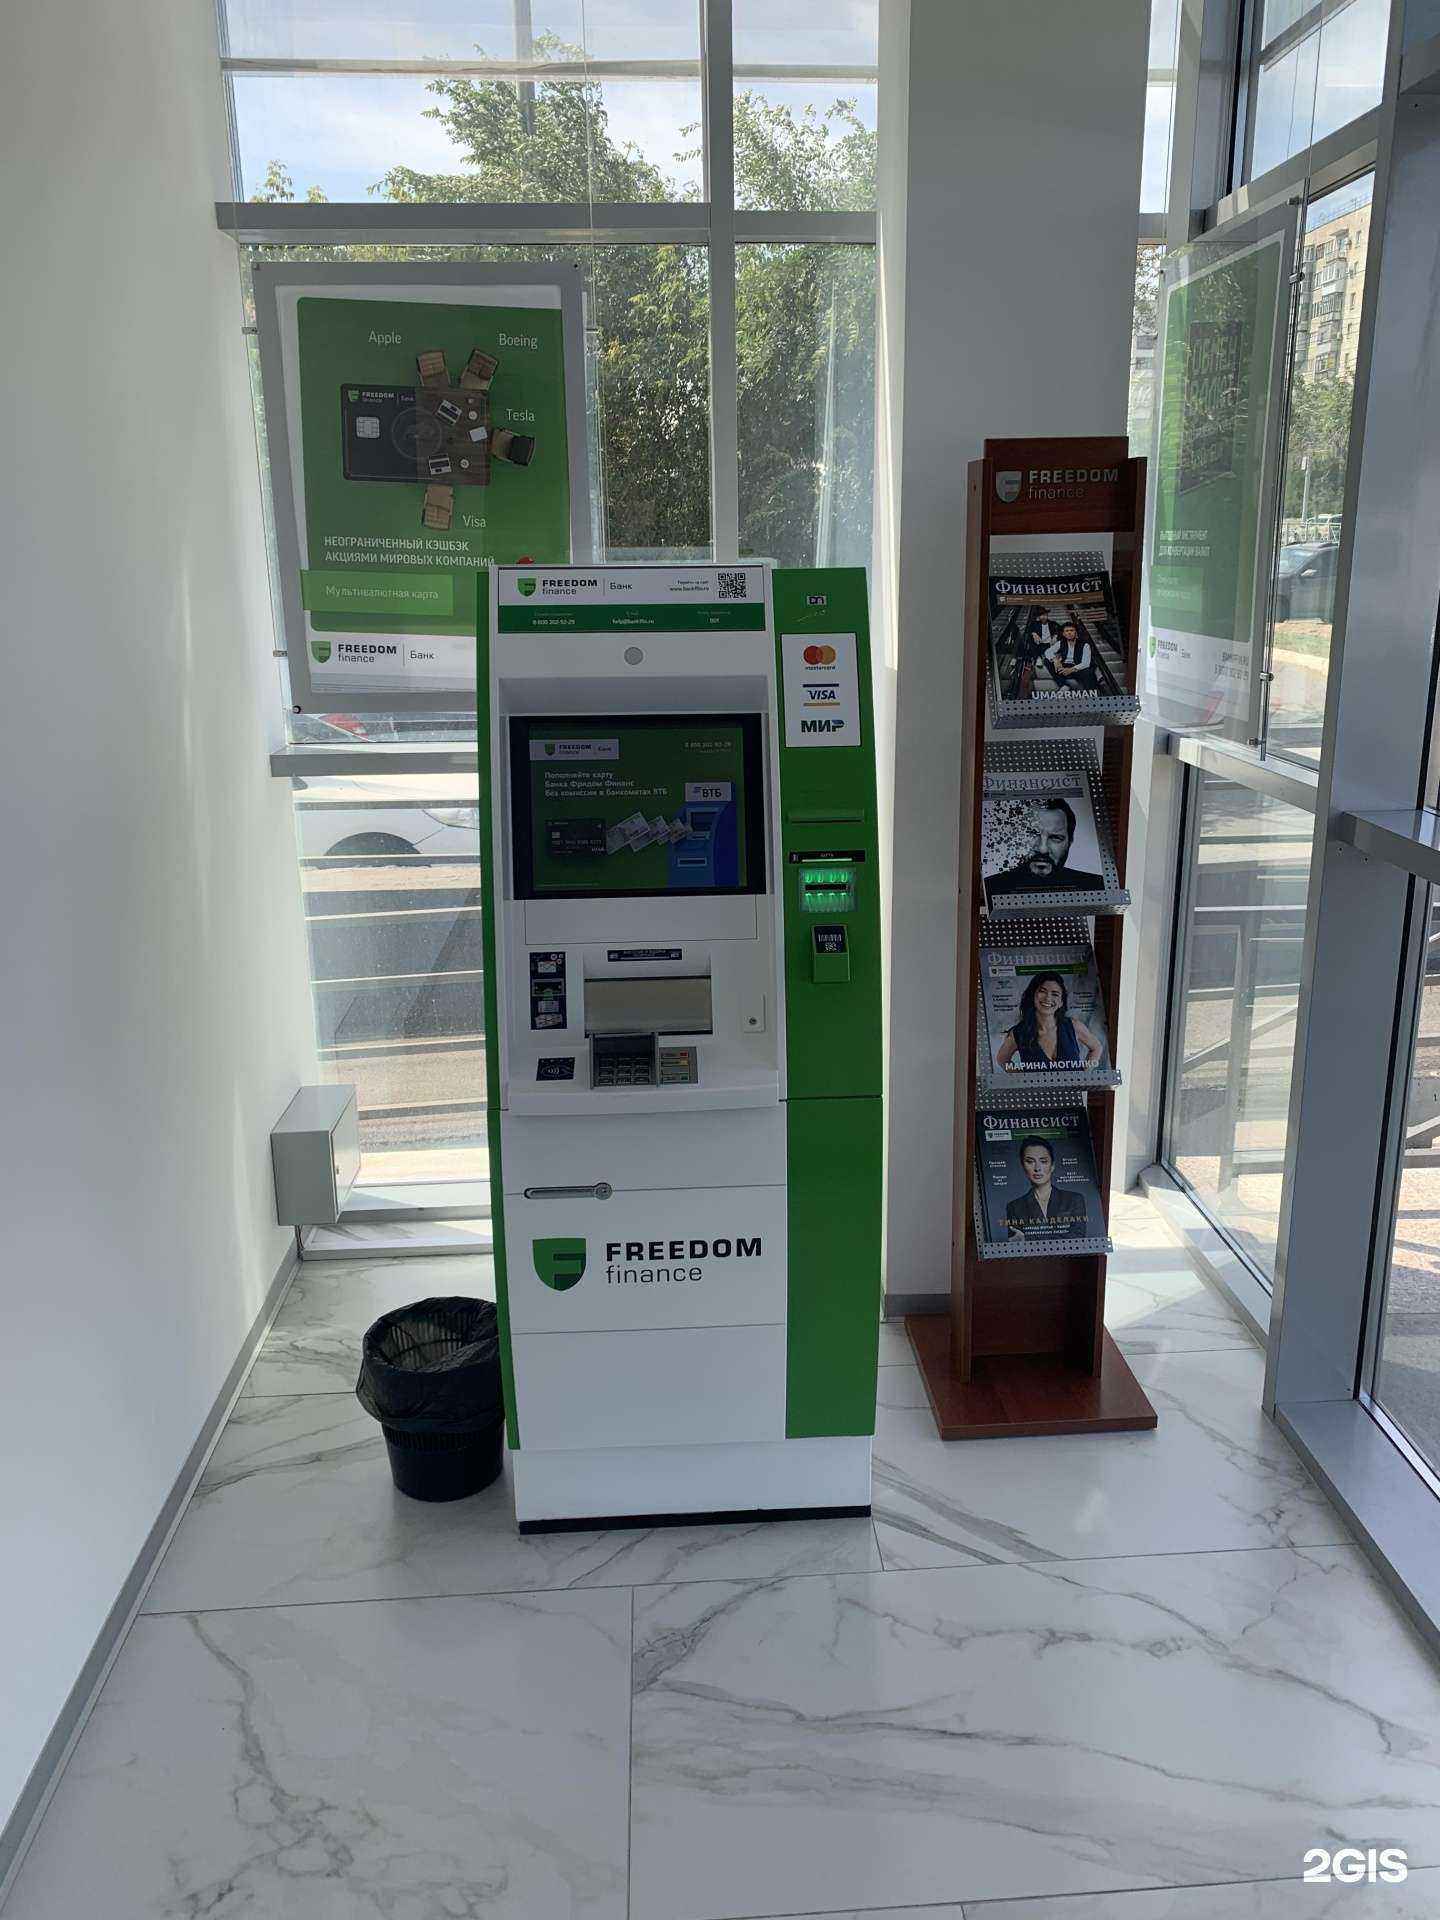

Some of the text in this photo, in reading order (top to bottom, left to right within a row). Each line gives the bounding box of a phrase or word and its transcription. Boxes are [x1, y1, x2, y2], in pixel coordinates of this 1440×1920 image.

[369, 330, 402, 345] Apple
[498, 333, 538, 350] Boeing
[506, 408, 536, 422] Tesla
[1029, 469, 1119, 483] FREEDOM
[1029, 486, 1085, 499] finance
[463, 515, 487, 528] Visa
[324, 536, 469, 551] НЕОГРАНИЧЕННЫЙ КЭШБЭК
[325, 551, 496, 567] АКЦИЯМИ МИРОВЫХ КОМПАНИЙ
[542, 579, 597, 587] FREEDOM
[610, 582, 632, 590] Банк
[995, 579, 1102, 593] Финансист
[326, 585, 439, 601] Мультивалютная карта
[542, 587, 577, 595] finance
[338, 644, 397, 654] FREEDOM
[410, 650, 434, 660] Банк
[338, 654, 375, 663] finance
[808, 690, 836, 700] VISA
[1031, 689, 1098, 700] UMA2RMAN
[801, 720, 844, 732] МИР
[702, 788, 721, 798] ВТБ
[1004, 1060, 1099, 1071] МАРИНА МОГИЛКО
[983, 1115, 1079, 1129] Финансист
[1029, 1216, 1088, 1225] КАНДЕЛАКИ
[606, 1237, 762, 1262] FREEDOM
[606, 1264, 703, 1284] finance
